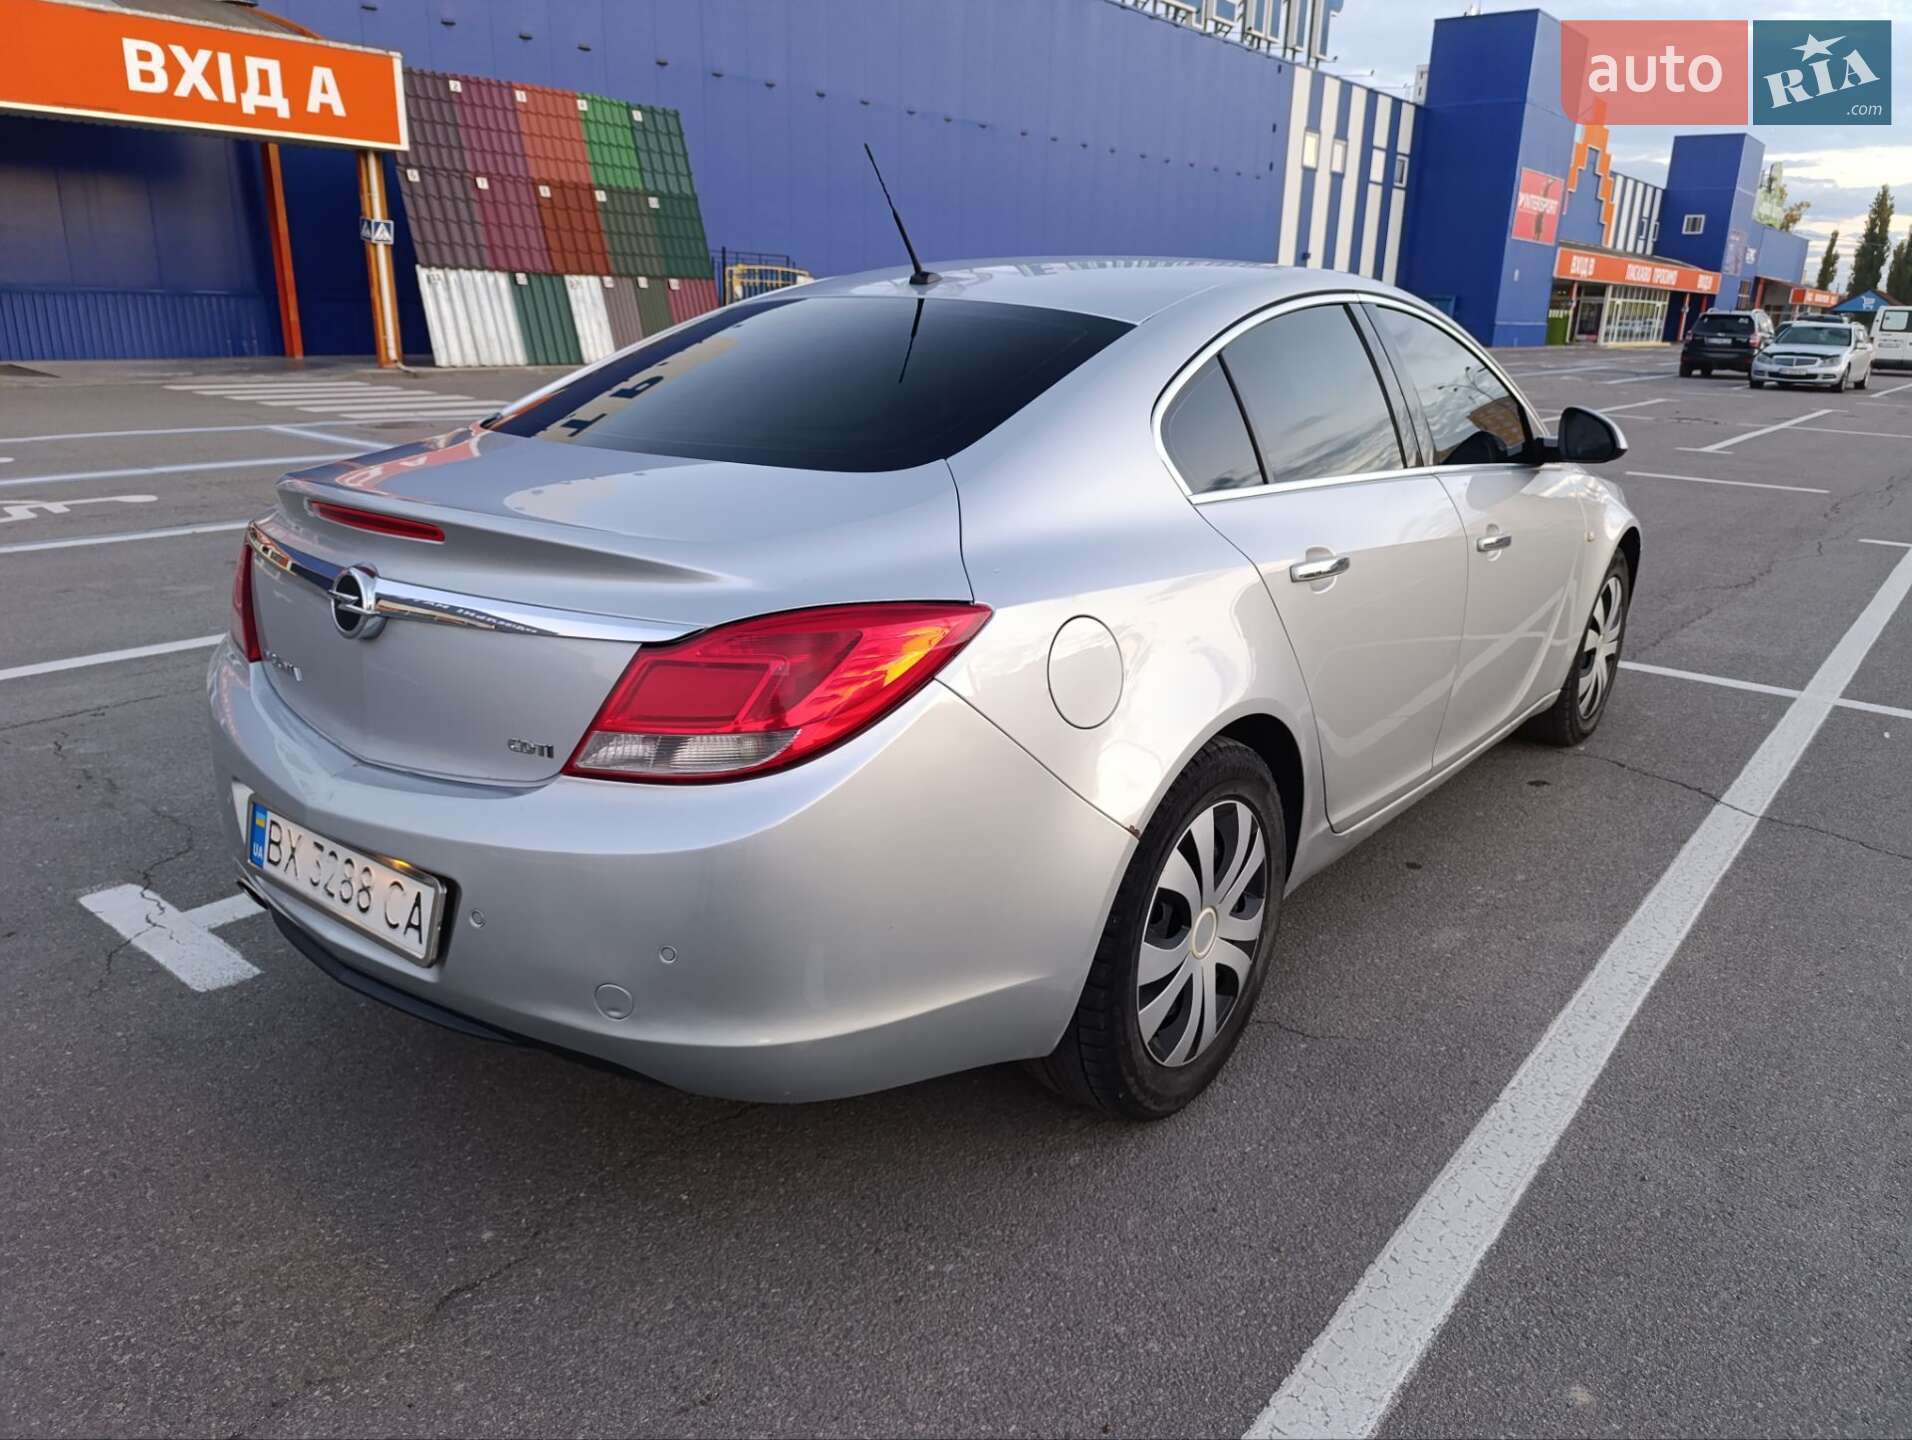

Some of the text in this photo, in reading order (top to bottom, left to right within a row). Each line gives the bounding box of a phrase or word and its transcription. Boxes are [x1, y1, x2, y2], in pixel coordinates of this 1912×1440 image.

[122, 37, 347, 119] ВХІД А
[253, 842, 263, 859] UA
